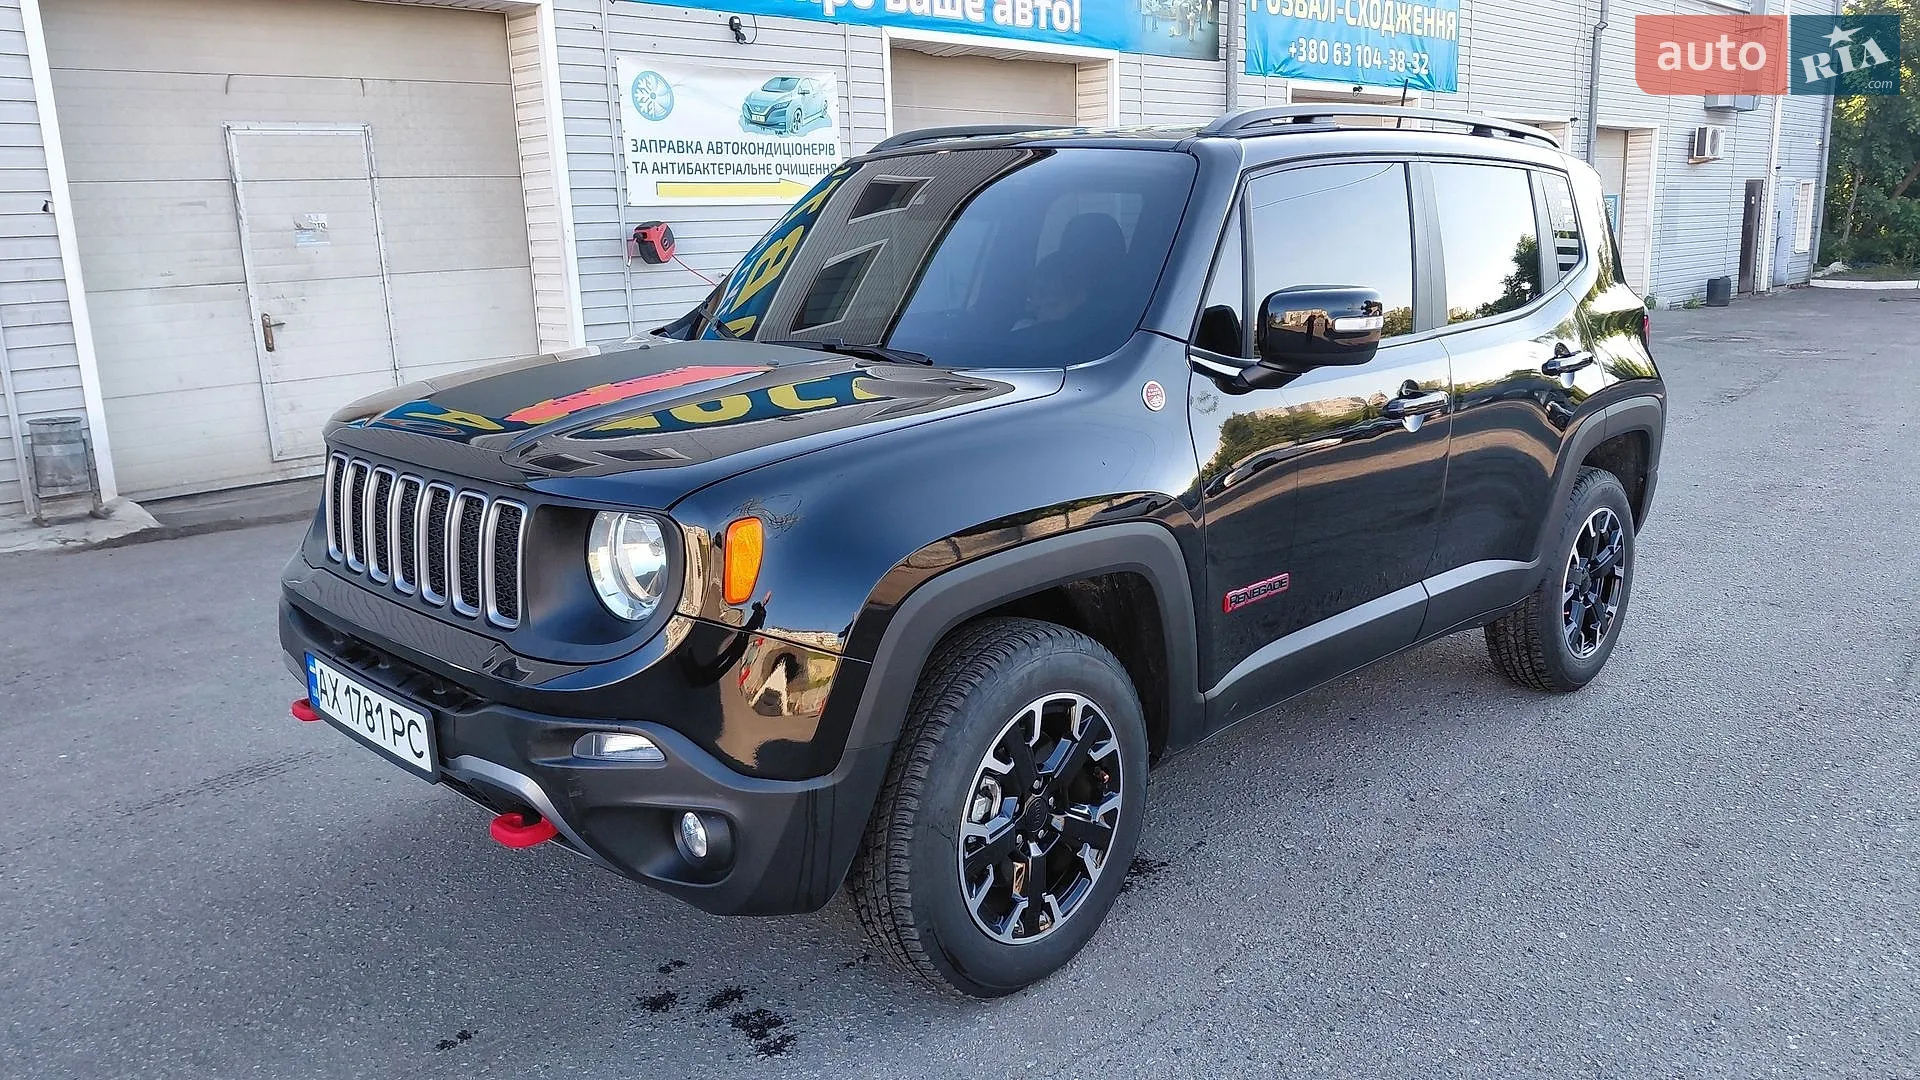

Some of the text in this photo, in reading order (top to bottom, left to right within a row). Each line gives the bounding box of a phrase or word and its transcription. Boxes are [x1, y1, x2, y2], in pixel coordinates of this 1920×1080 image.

[992, 0, 1081, 33] авто!
[1288, 37, 1429, 75] +380 63 104-38-32
[631, 138, 836, 158] ЗАПРАВКА АВТОКОНДИЦІОНЕРІВ
[632, 161, 648, 174] ТА
[651, 162, 772, 175] АНТИБАКТЕРІАЛЬНЕ
[1228, 576, 1289, 608] RENEGADE
[319, 668, 425, 759] AX 1781 PC
